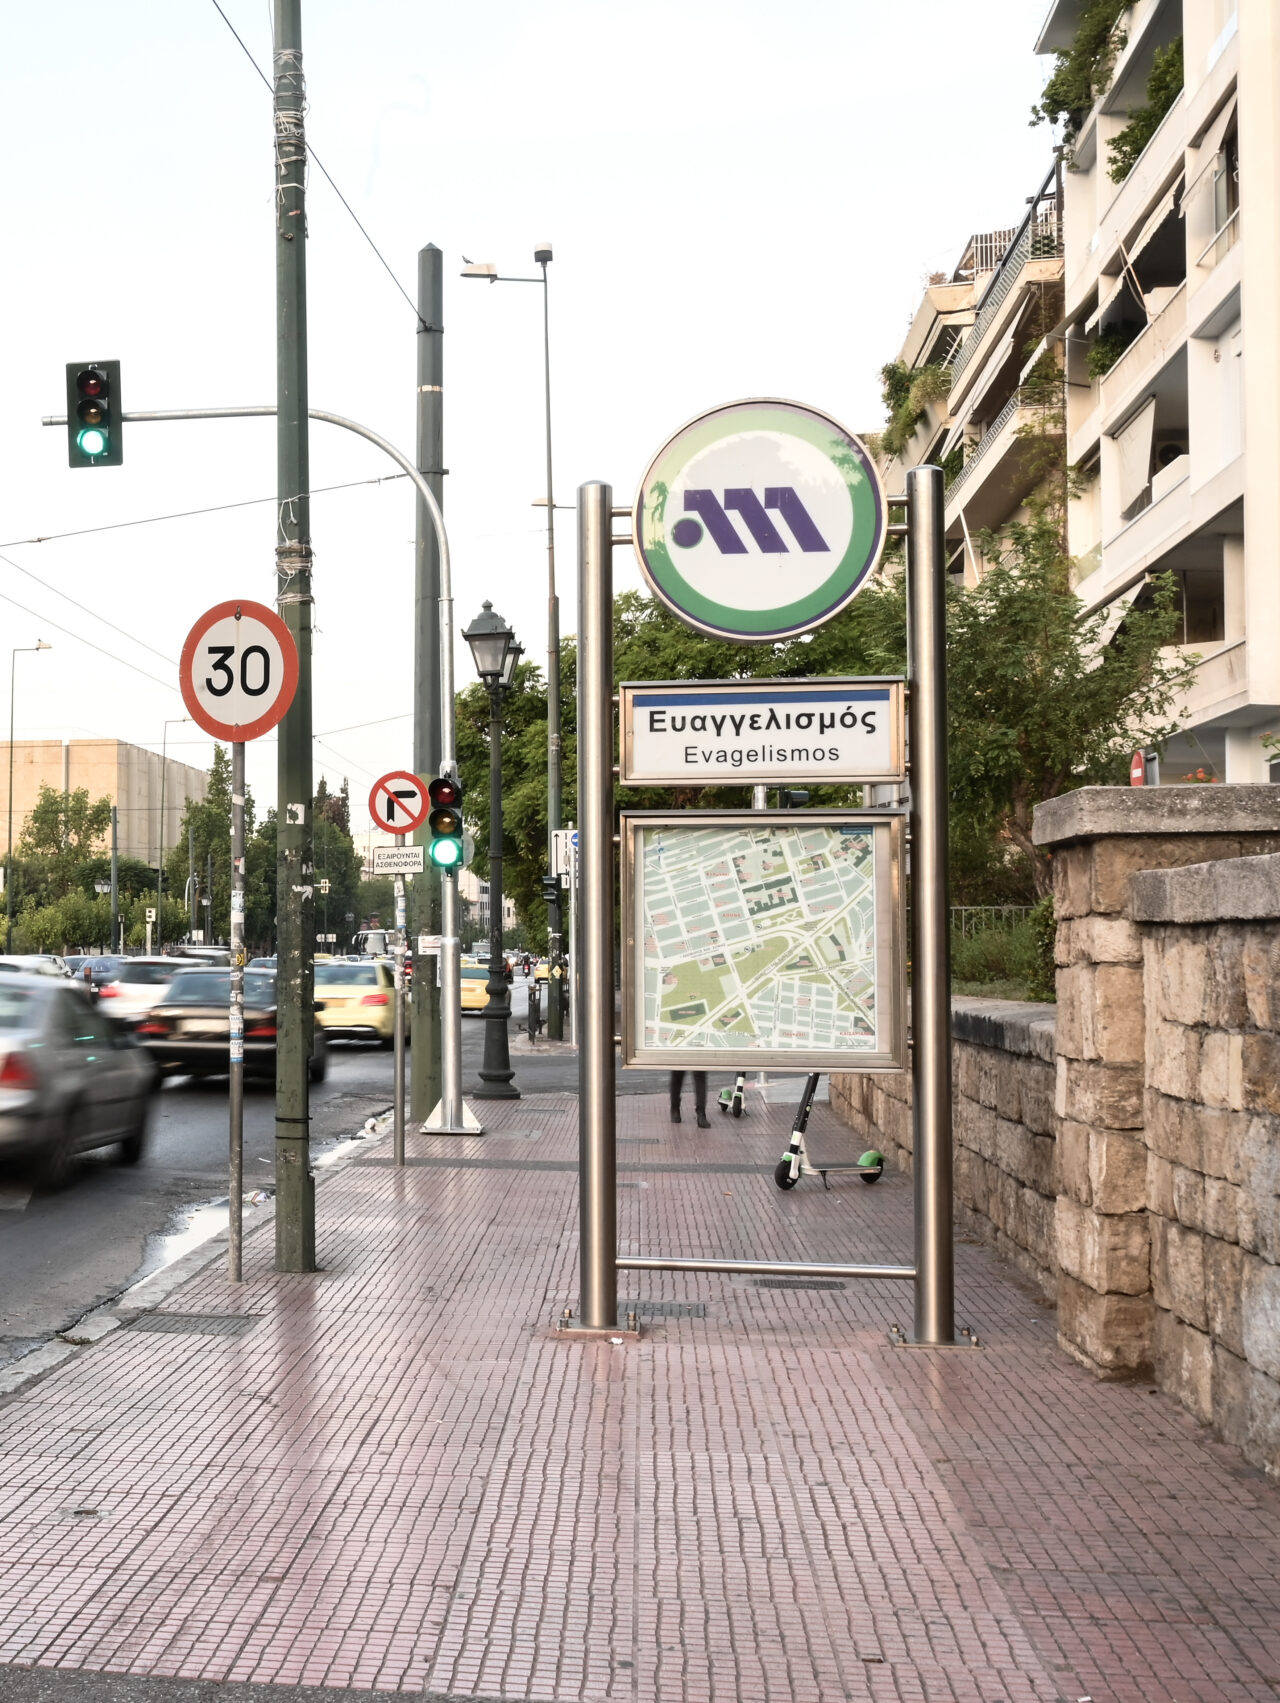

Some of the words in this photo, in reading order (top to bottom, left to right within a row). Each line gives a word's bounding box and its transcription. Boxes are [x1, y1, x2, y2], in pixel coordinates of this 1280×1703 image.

[205, 645, 271, 697] 30
[648, 705, 877, 737] Ευαγγελισμός
[684, 744, 840, 767] Evagelismos
[375, 860, 422, 868] ΑΣΘΕΝΟΦΟΡΑ
[377, 852, 420, 860] ΕΞΑΙΡΟΥΝΤΑΙ
